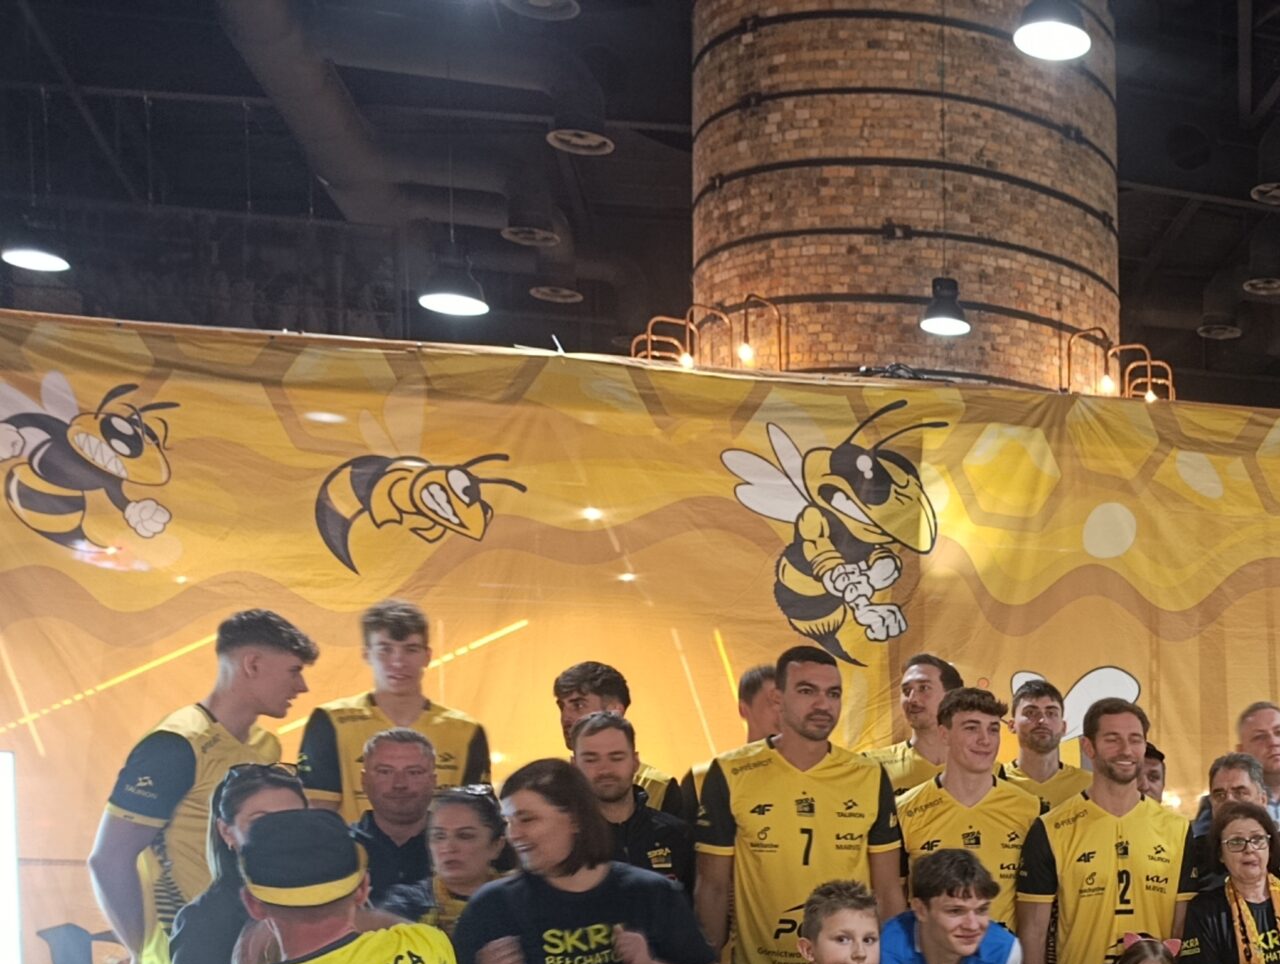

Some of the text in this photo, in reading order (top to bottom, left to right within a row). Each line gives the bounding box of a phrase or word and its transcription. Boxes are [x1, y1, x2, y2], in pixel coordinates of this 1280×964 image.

[750, 804, 774, 816] 4F
[800, 828, 813, 866] 7
[920, 840, 941, 851] 4F
[1076, 851, 1096, 863] 4F
[542, 923, 624, 955] SKR
